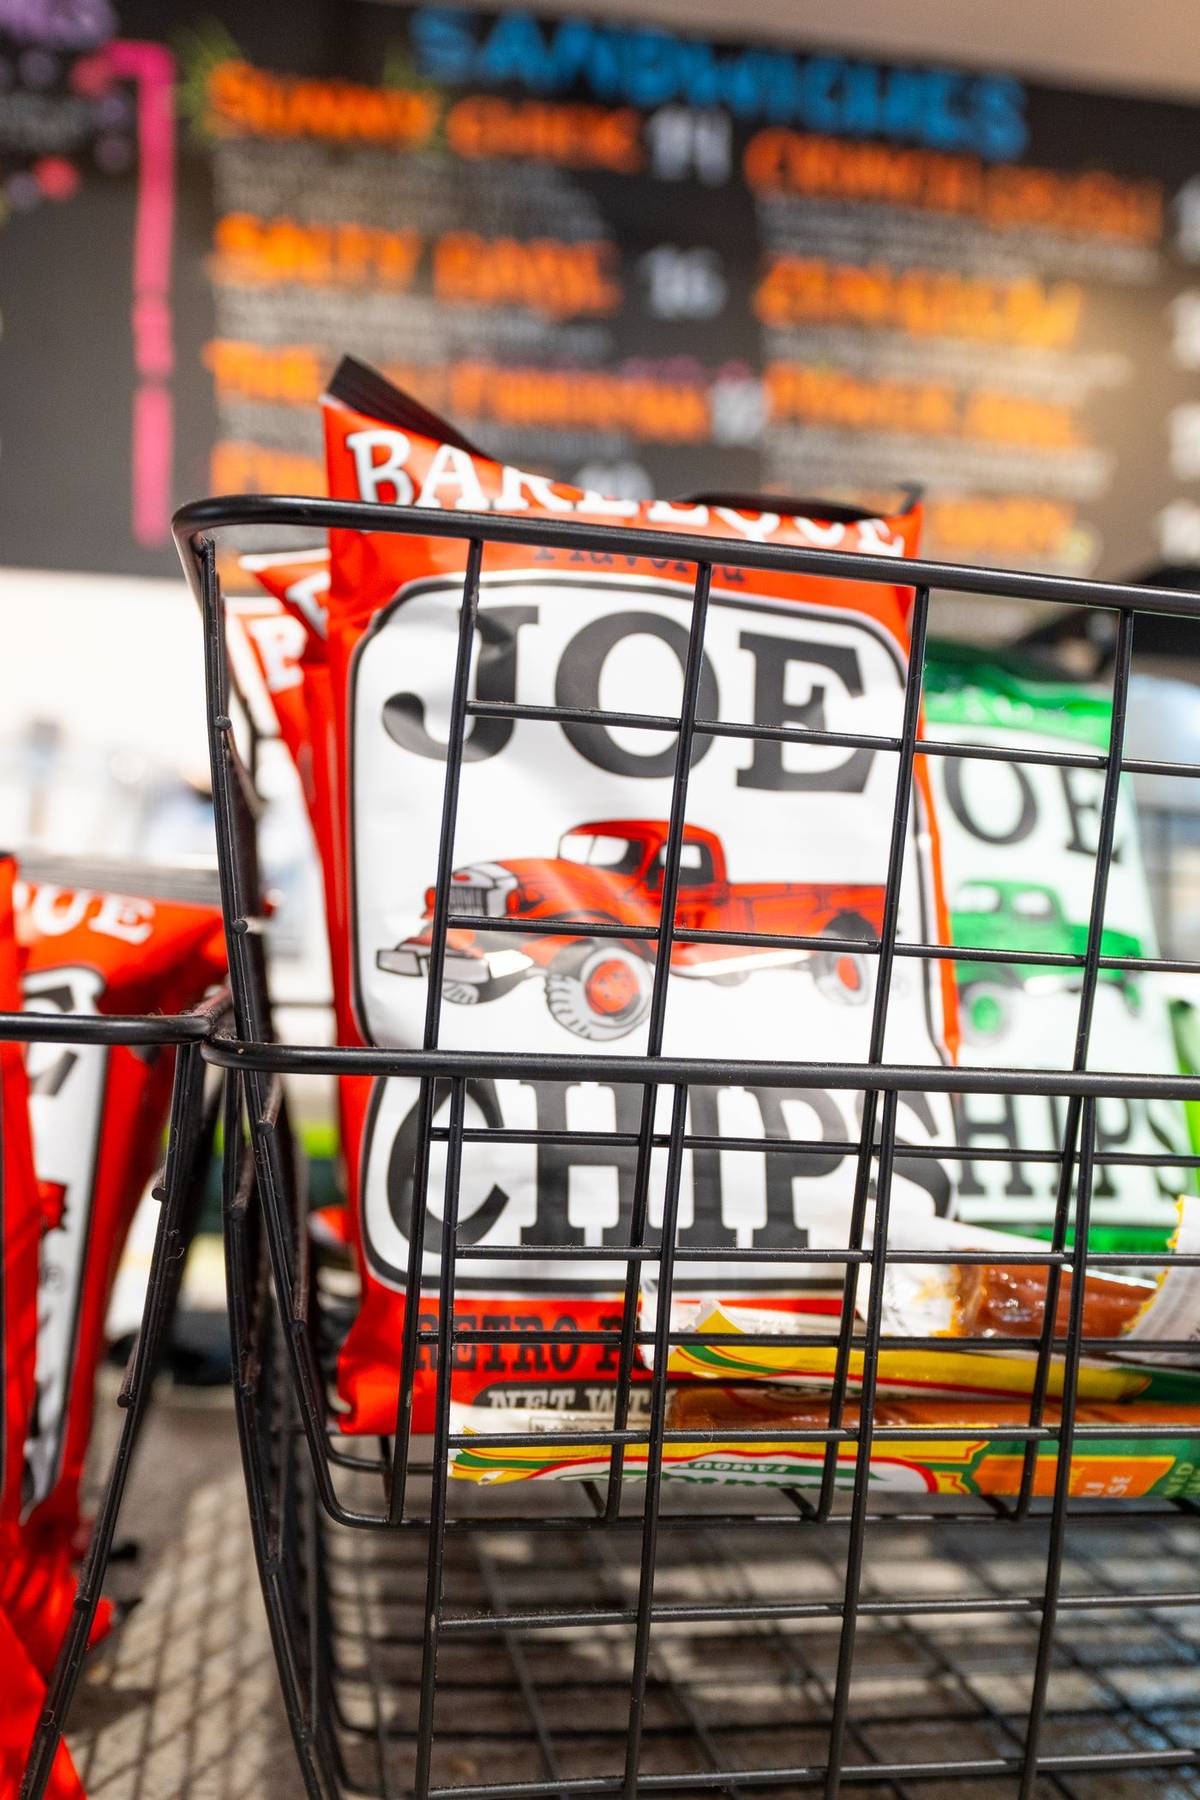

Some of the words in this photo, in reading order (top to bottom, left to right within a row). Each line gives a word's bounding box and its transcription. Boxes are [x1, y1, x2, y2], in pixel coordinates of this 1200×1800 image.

[382, 605, 877, 793] JOE
[386, 1077, 951, 1254] CHIPS
[408, 1314, 580, 1372] RETRO
